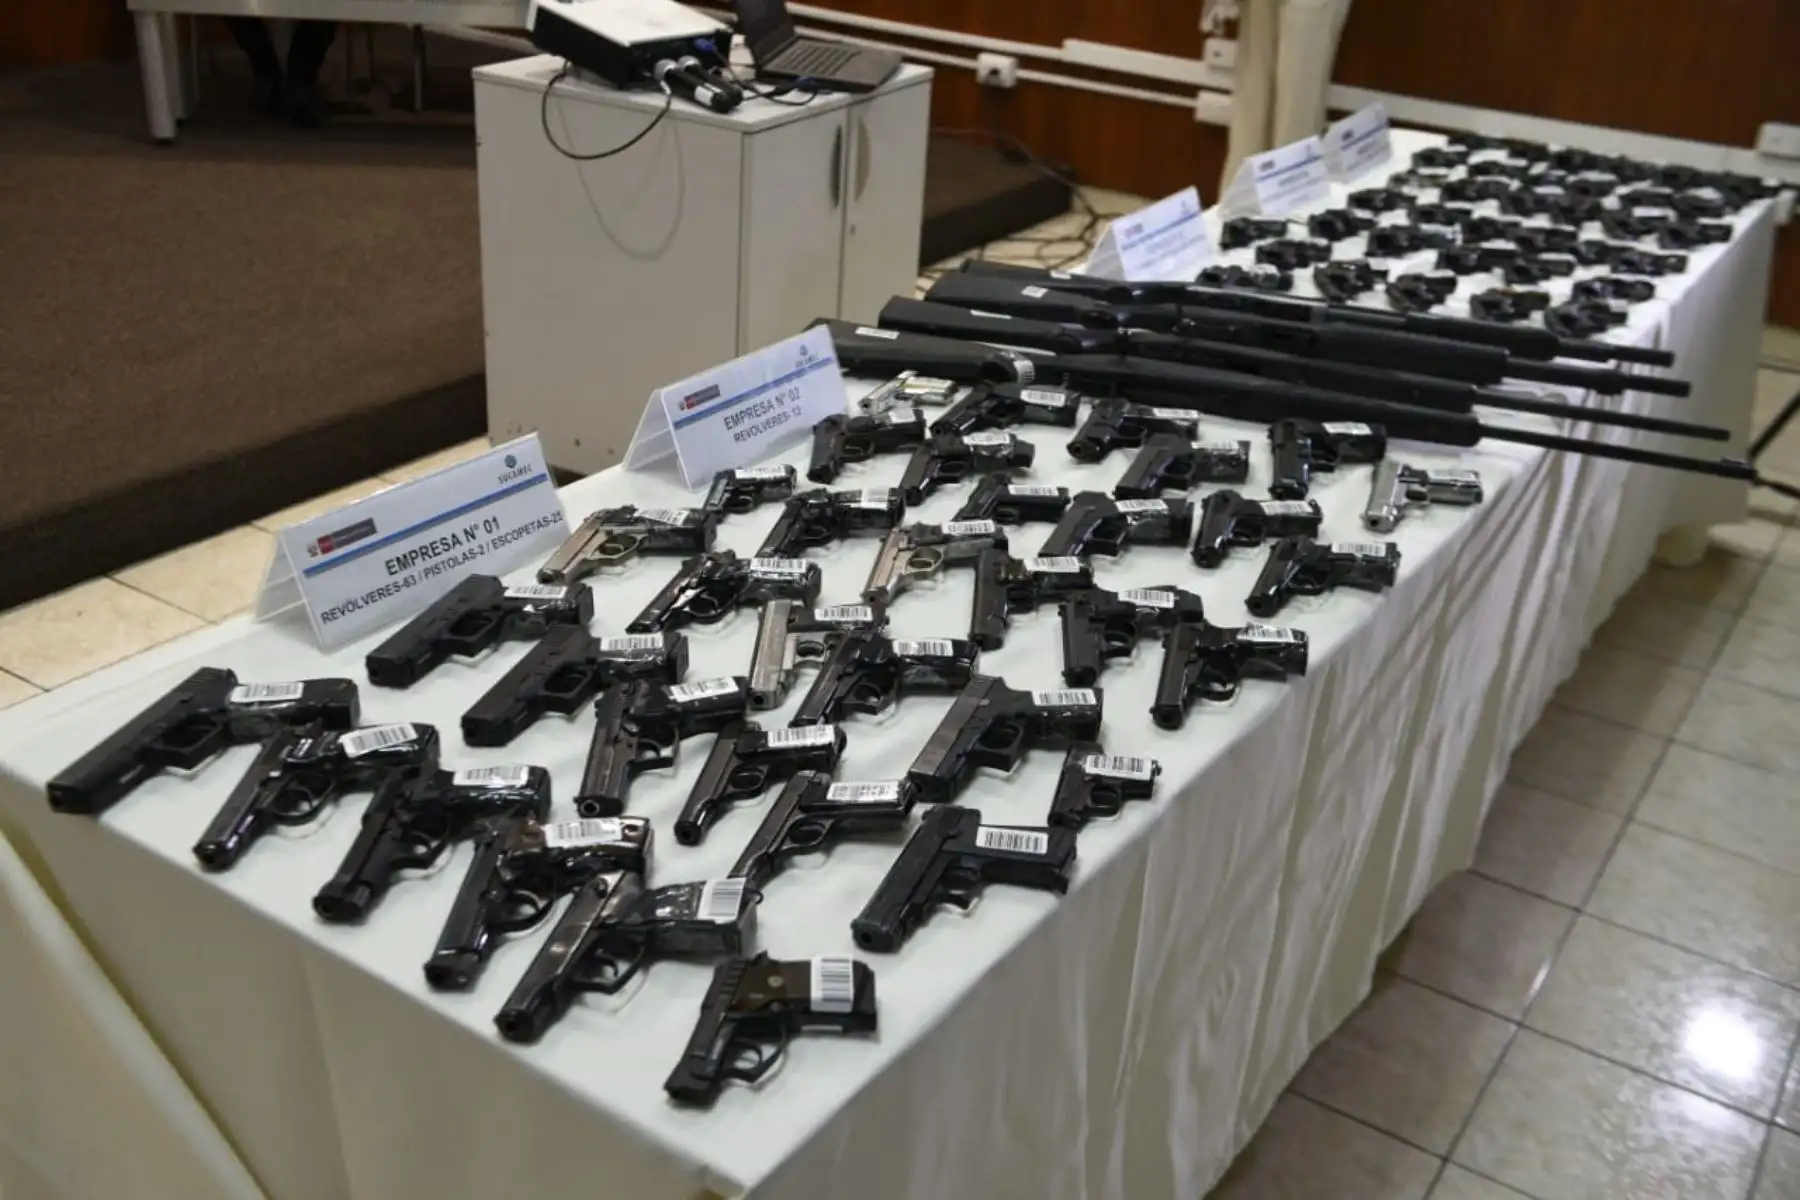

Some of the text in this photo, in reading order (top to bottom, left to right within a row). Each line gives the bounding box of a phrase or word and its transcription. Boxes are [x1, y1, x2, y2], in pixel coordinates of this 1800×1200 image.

[724, 398, 776, 431] EMPRESA
[788, 385, 801, 402] 02
[385, 533, 462, 576] EMPRESA
[463, 522, 480, 543] N°
[483, 516, 500, 534] 01
[423, 543, 485, 580] PISTOLAS-2
